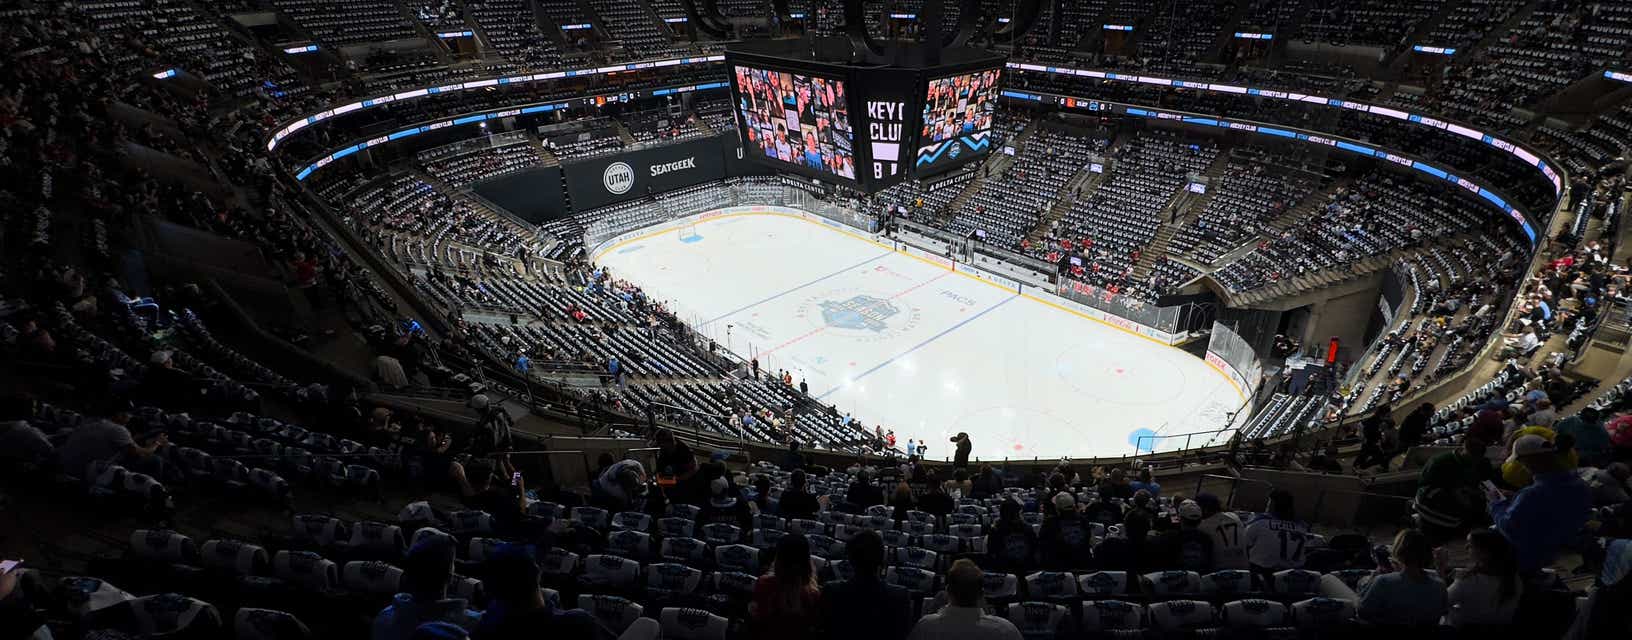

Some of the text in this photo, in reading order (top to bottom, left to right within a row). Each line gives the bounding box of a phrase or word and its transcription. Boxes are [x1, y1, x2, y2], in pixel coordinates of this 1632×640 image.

[867, 101, 896, 120] KEY
[870, 122, 902, 142] CLU
[650, 156, 697, 177] SEATGEEK
[608, 171, 630, 186] UTAH
[935, 178, 954, 190] DELTA
[1216, 522, 1238, 547] 17
[1278, 531, 1305, 561] 17
